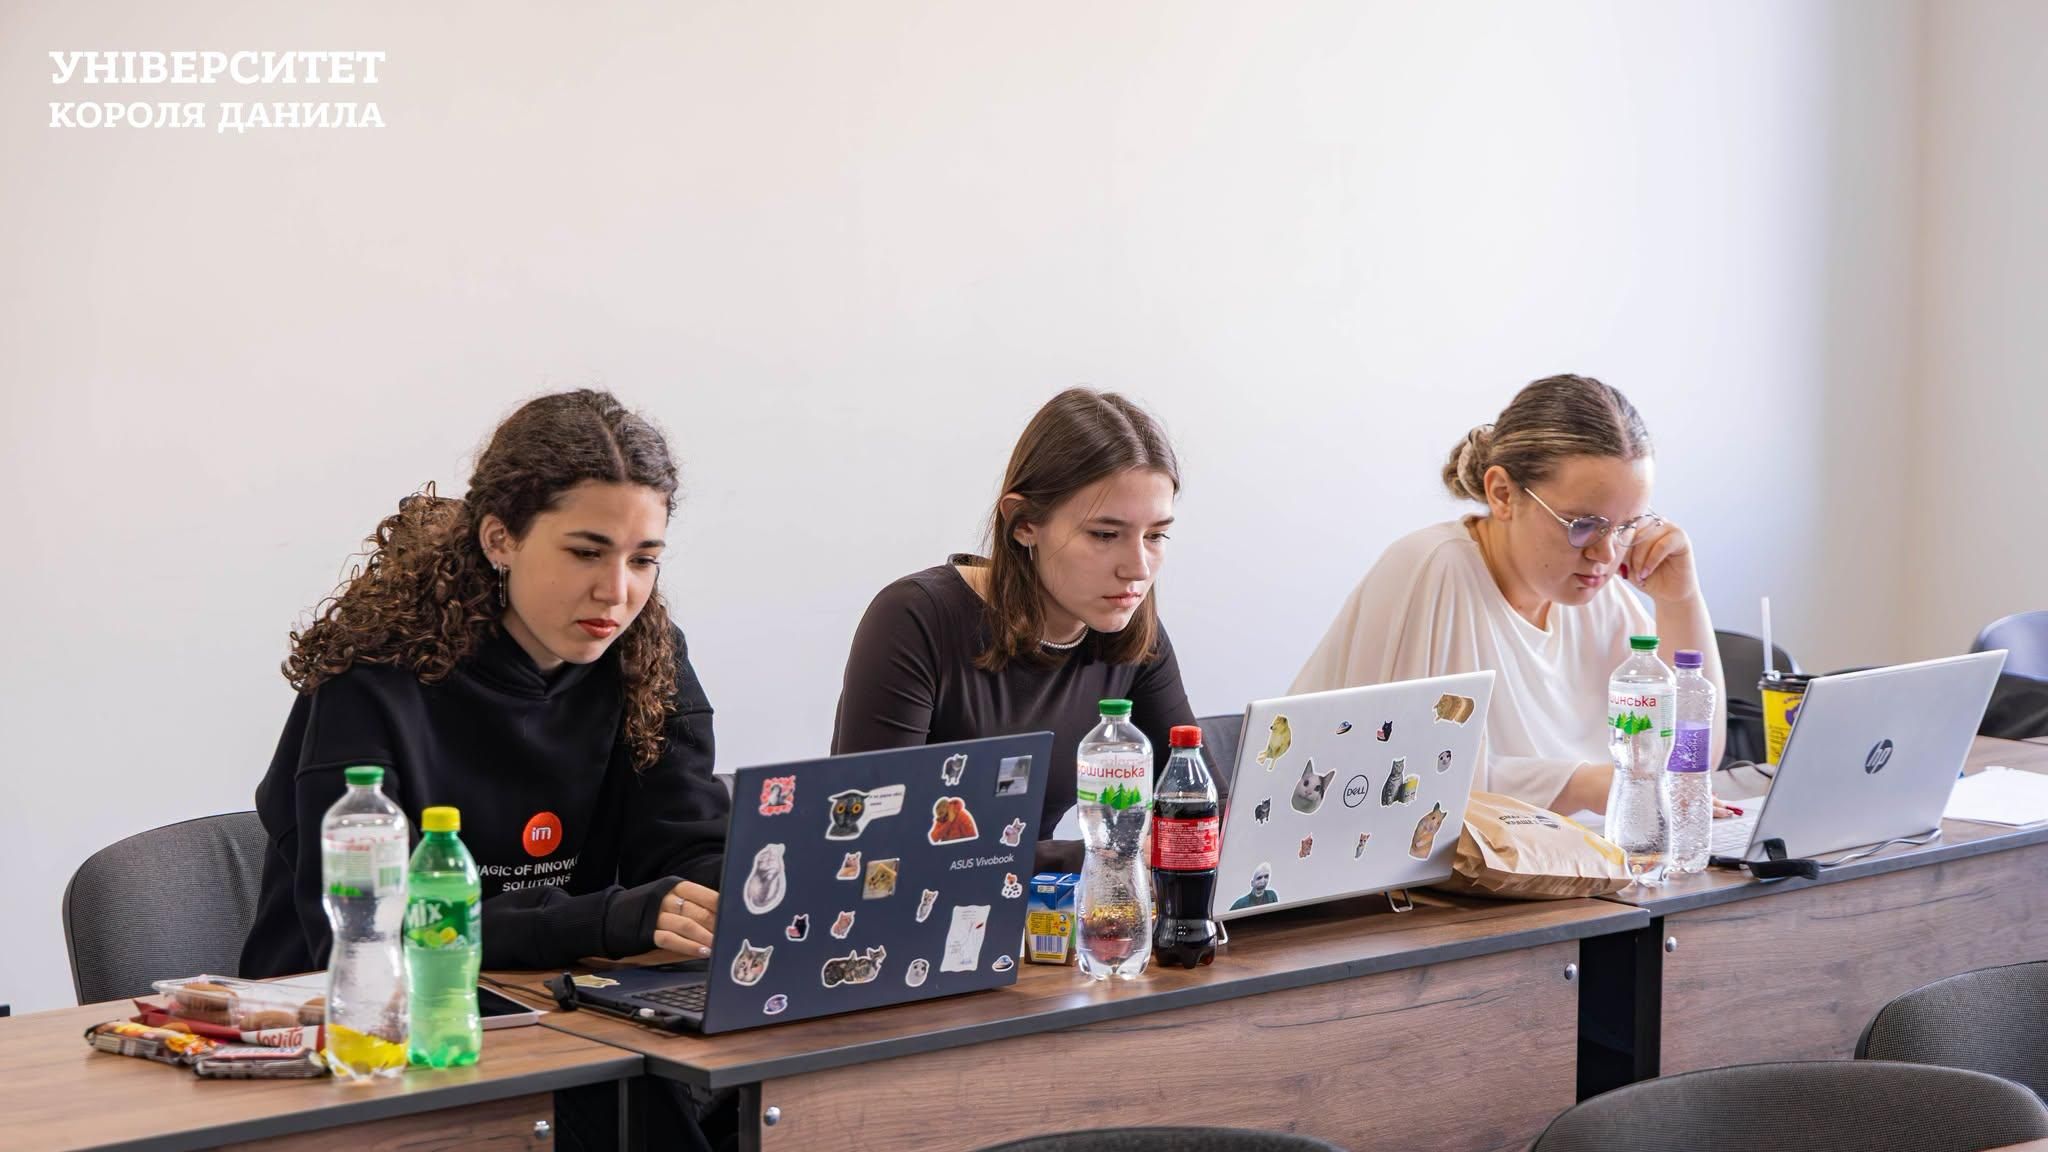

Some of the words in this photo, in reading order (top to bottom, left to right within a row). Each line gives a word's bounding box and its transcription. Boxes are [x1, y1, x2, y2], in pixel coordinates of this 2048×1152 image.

[1867, 741, 1893, 773] hp
[1079, 764, 1145, 778] ршинська
[514, 864, 533, 876] OF
[949, 858, 974, 871] ASUS
[975, 853, 1015, 867] Vivobook
